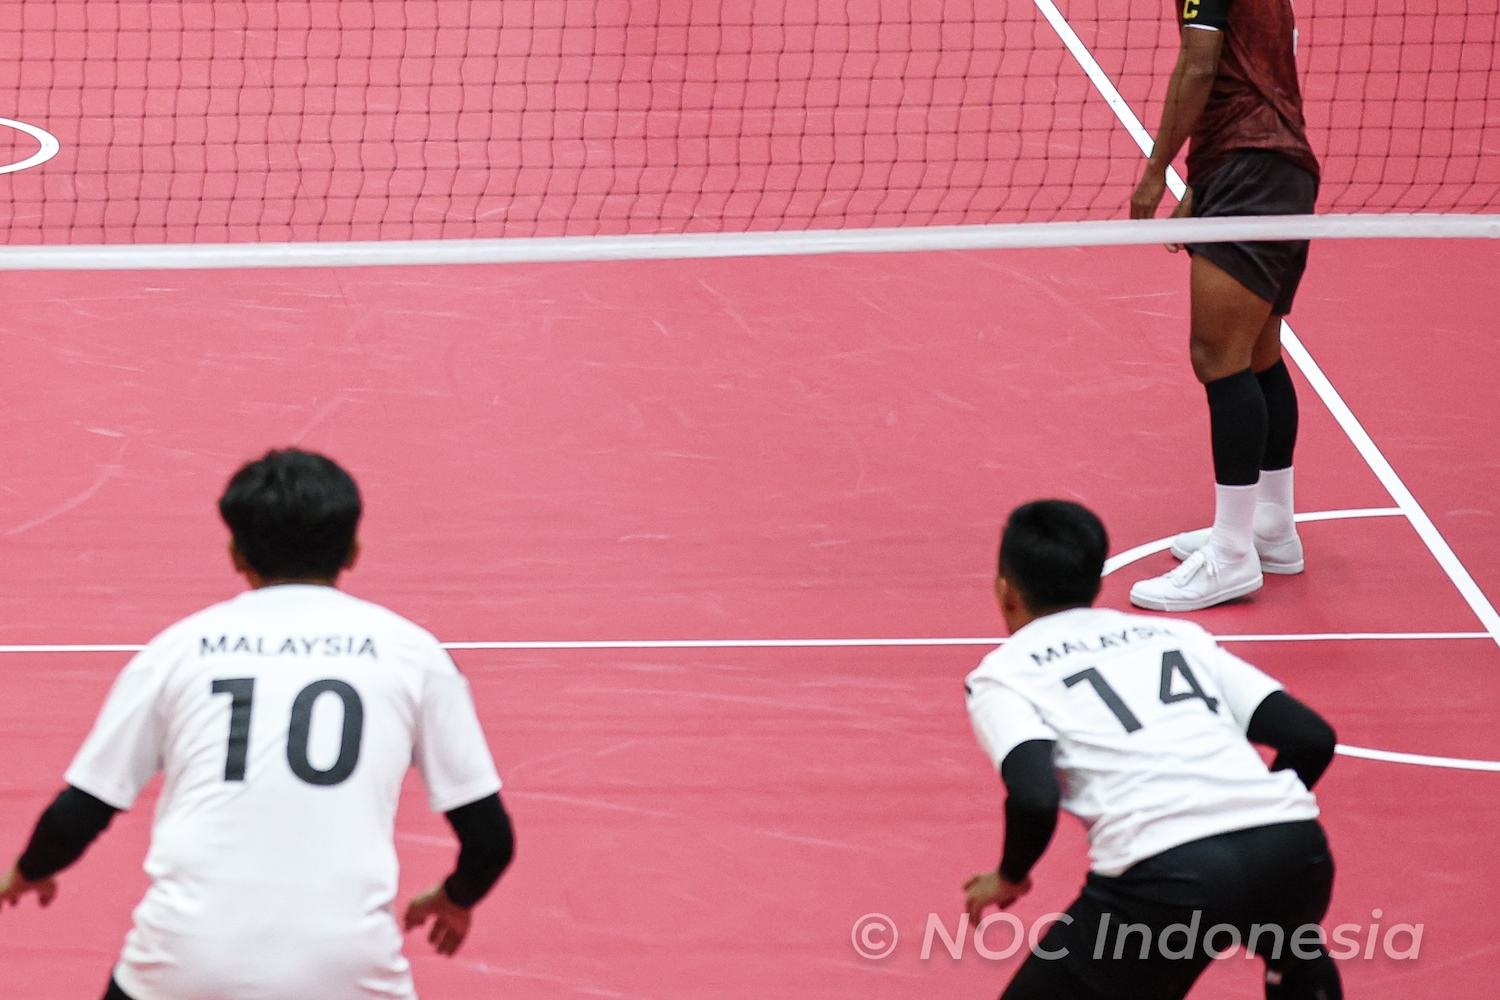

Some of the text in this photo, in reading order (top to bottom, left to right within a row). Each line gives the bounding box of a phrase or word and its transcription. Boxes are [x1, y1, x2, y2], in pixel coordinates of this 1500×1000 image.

[199, 634, 378, 659] MALAYSIA
[211, 677, 364, 787] 10
[1062, 650, 1219, 733] 14
